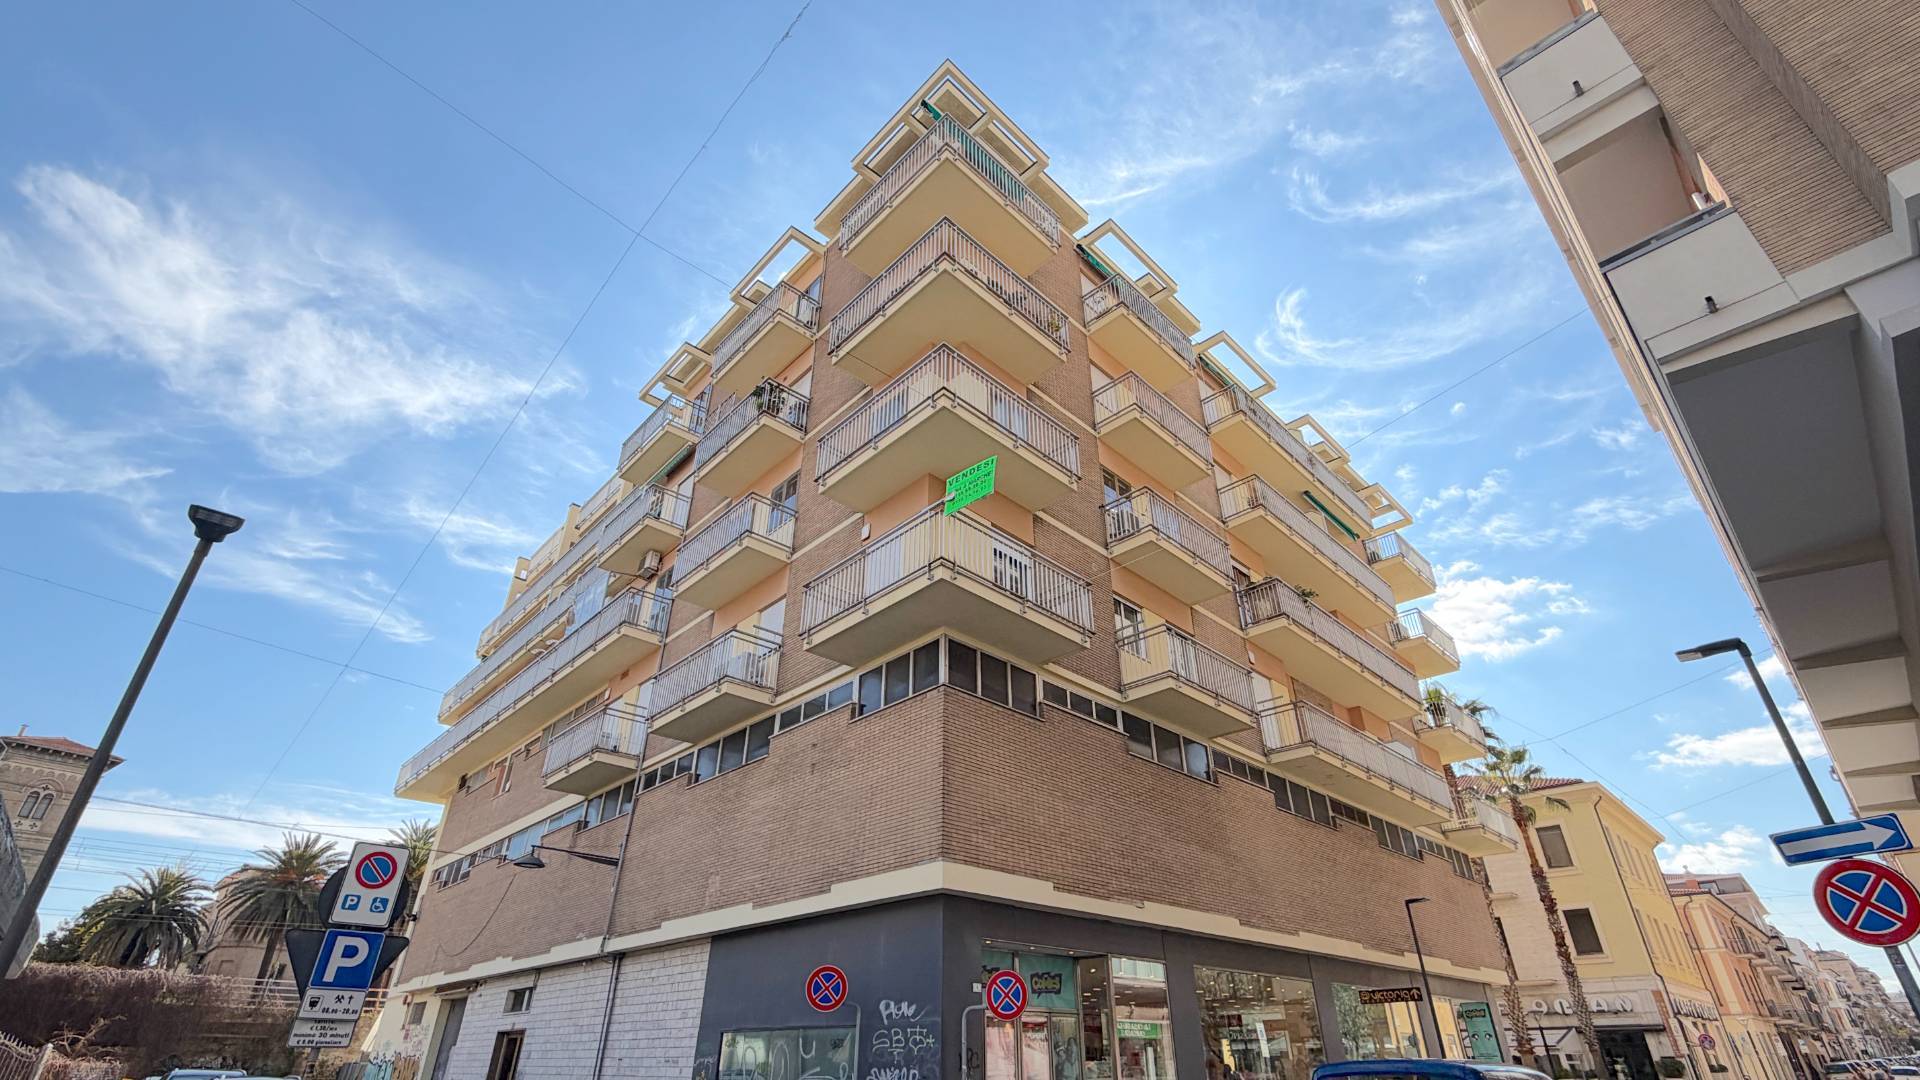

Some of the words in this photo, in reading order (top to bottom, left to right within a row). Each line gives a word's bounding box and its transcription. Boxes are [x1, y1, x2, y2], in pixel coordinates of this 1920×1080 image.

[948, 458, 994, 486] VENDESI
[345, 896, 359, 910] P
[322, 935, 369, 983] P
